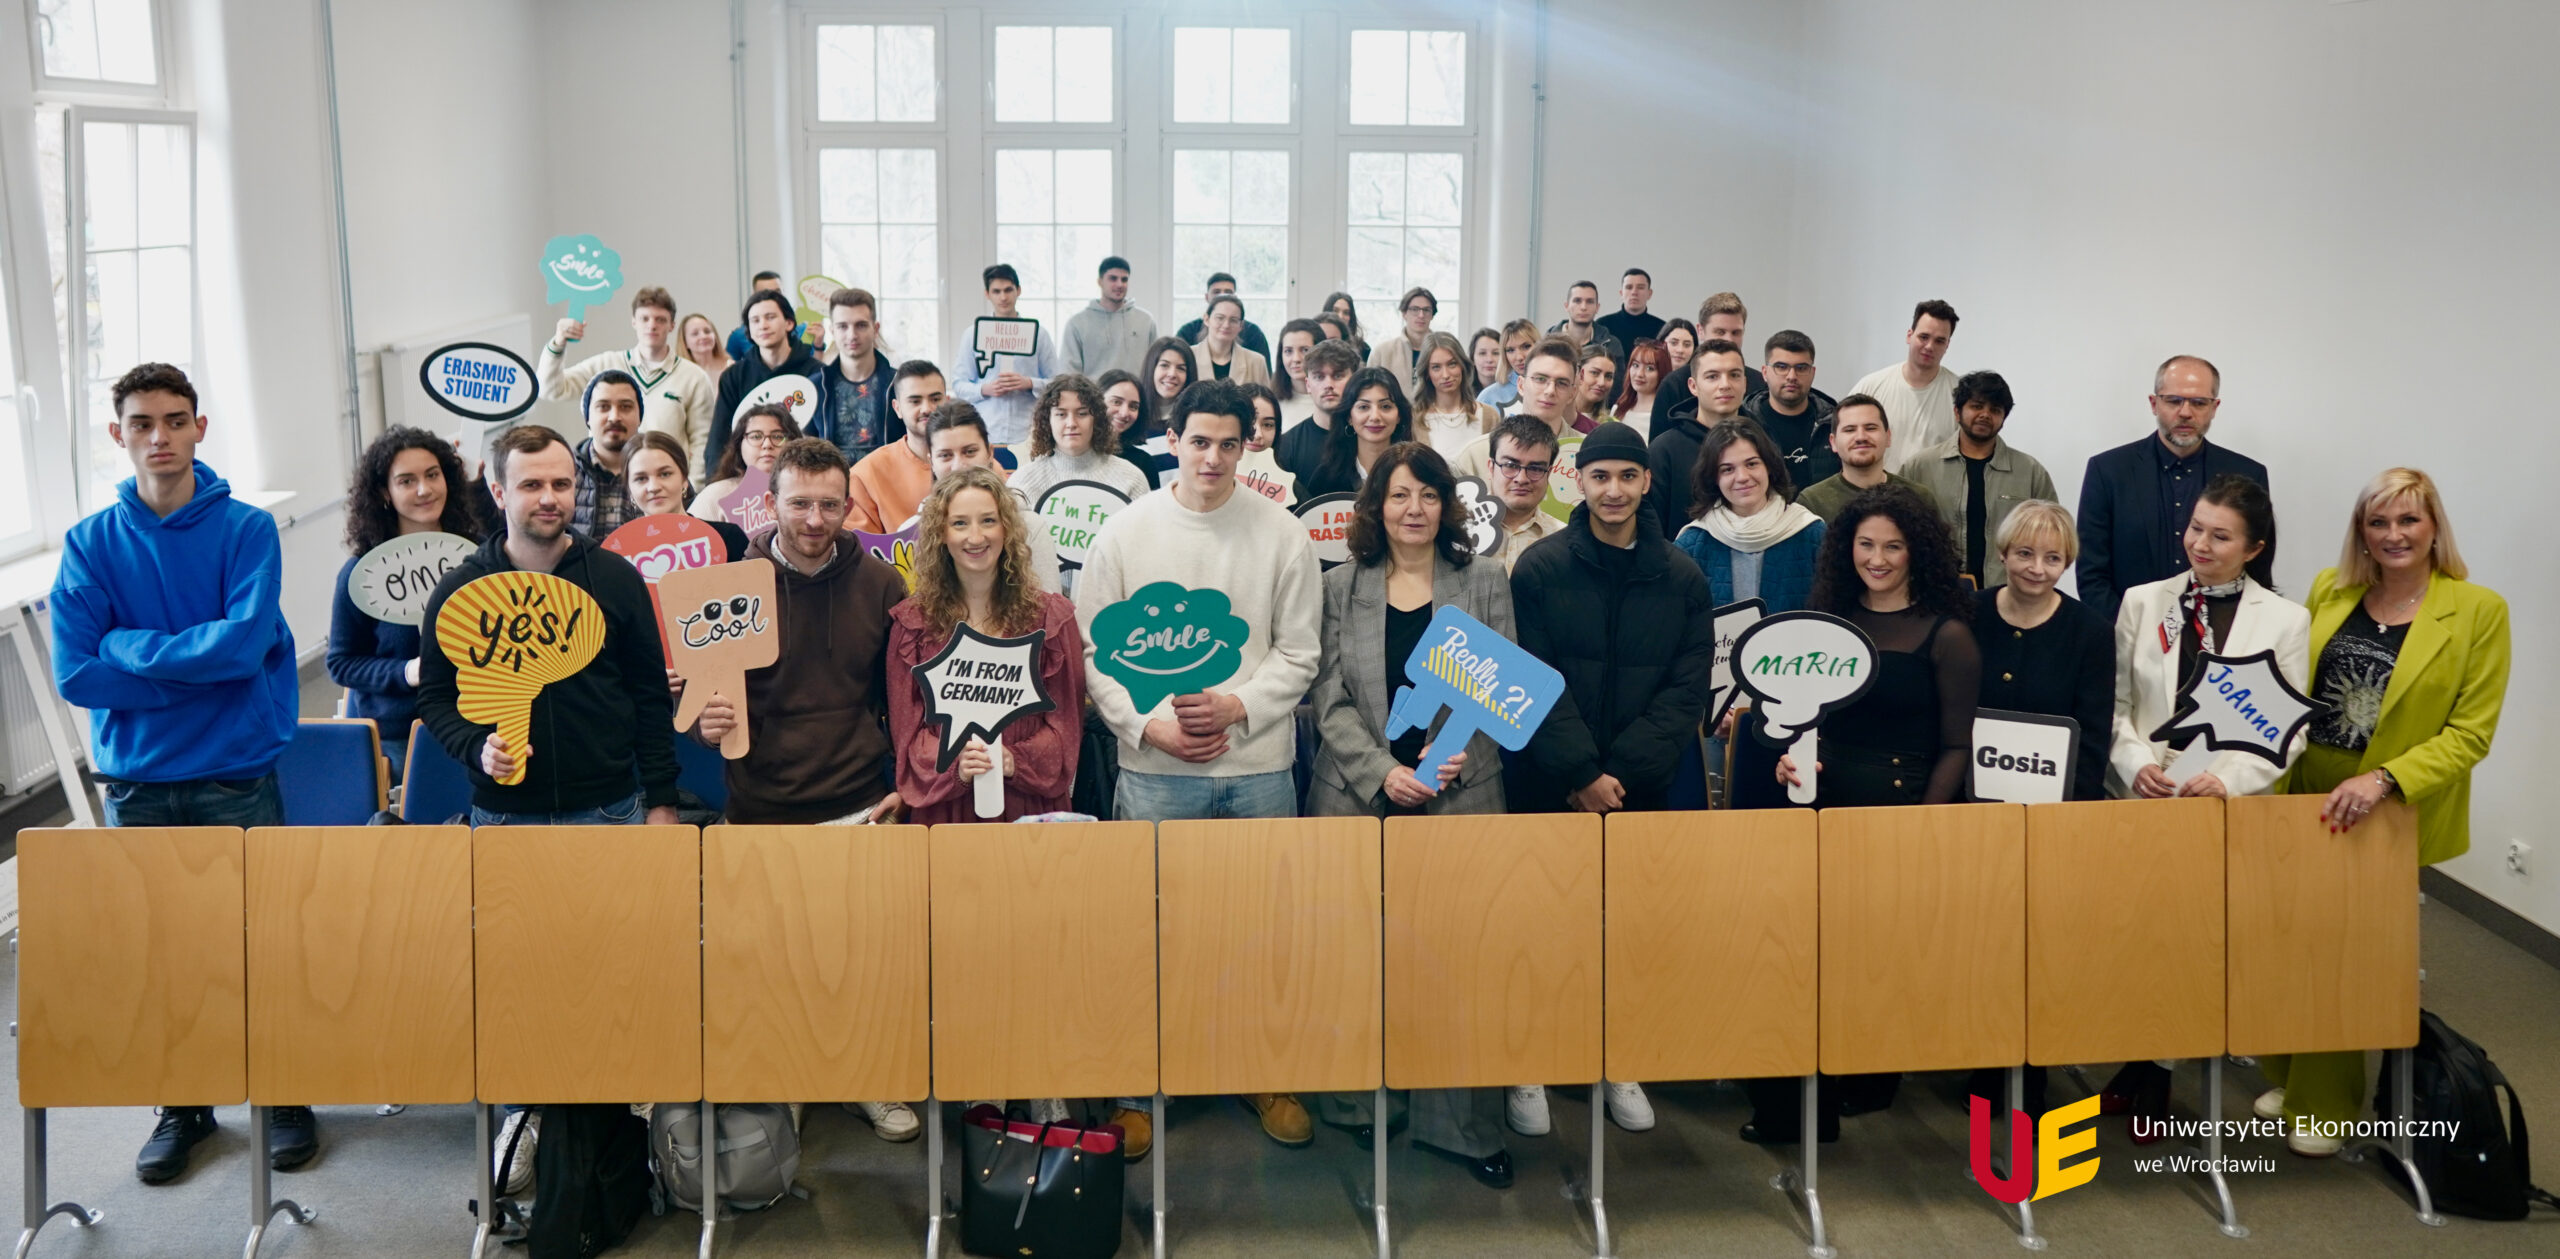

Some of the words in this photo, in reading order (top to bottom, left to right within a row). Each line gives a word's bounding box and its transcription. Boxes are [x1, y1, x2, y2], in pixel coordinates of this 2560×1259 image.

[556, 253, 605, 279] Smile
[994, 322, 1019, 335] HELLO
[985, 336, 1027, 350] POLAND!!!
[443, 356, 517, 385] ERASMUS
[444, 377, 511, 404] STUDENT
[1246, 469, 1283, 499] llo
[1047, 497, 1079, 519] I'm
[1089, 504, 1109, 525] Fr
[1323, 512, 1329, 525] I
[678, 597, 767, 647] Cool
[469, 608, 581, 668] yes!
[1123, 624, 1210, 657] Smile
[946, 658, 974, 678] I'M
[975, 662, 1023, 682] FROM
[1751, 651, 1859, 677] MARIA
[940, 682, 1024, 707] GERMANY!
[2208, 665, 2280, 742] JoAnna
[1976, 745, 2057, 777] Gosia
